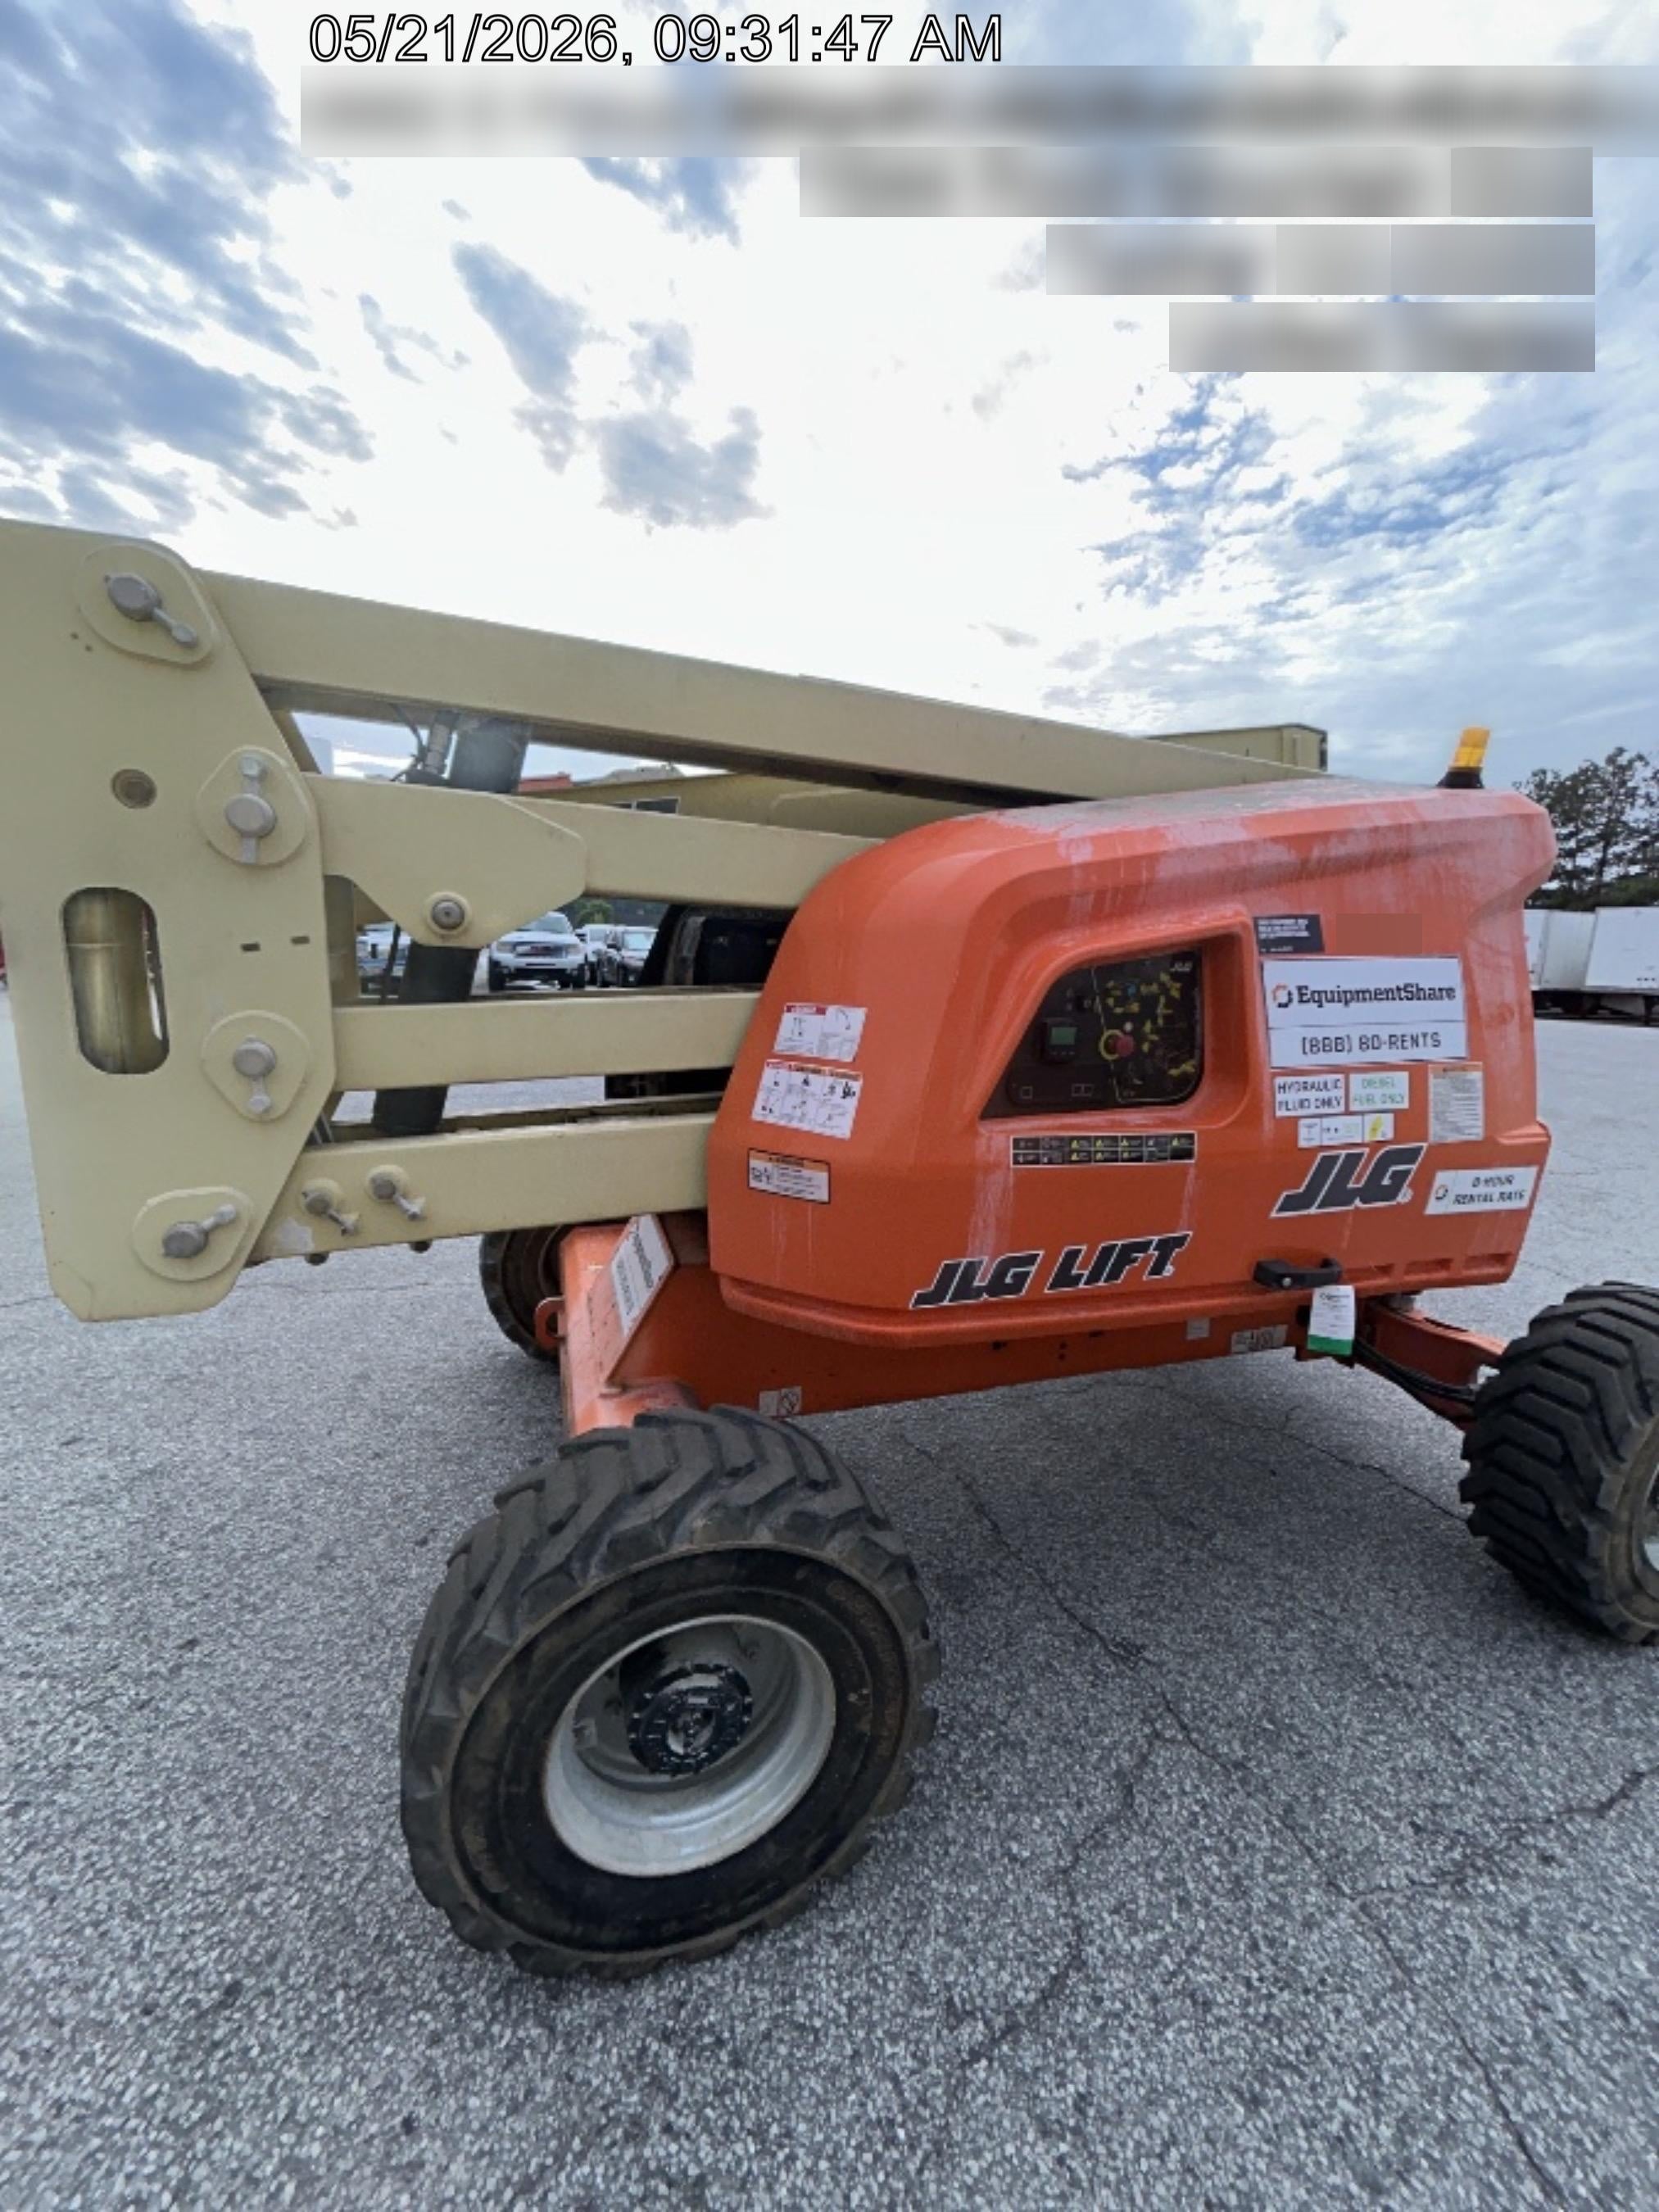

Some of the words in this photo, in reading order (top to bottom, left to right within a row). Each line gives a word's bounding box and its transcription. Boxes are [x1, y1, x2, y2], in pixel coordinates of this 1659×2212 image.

[1297, 983, 1457, 1009] EquipmentShare
[1358, 1032, 1442, 1053] 80-RENTS
[1277, 1078, 1342, 1095] HYDRAULIC
[1277, 1098, 1311, 1112] FLUID
[1314, 1095, 1342, 1109] ONLY
[1271, 1143, 1429, 1217] JLG
[1453, 1193, 1494, 1205] RENTAL
[1498, 1190, 1526, 1202] RATE
[909, 1242, 1045, 1310] JLG
[1044, 1231, 1193, 1293] LIFT
